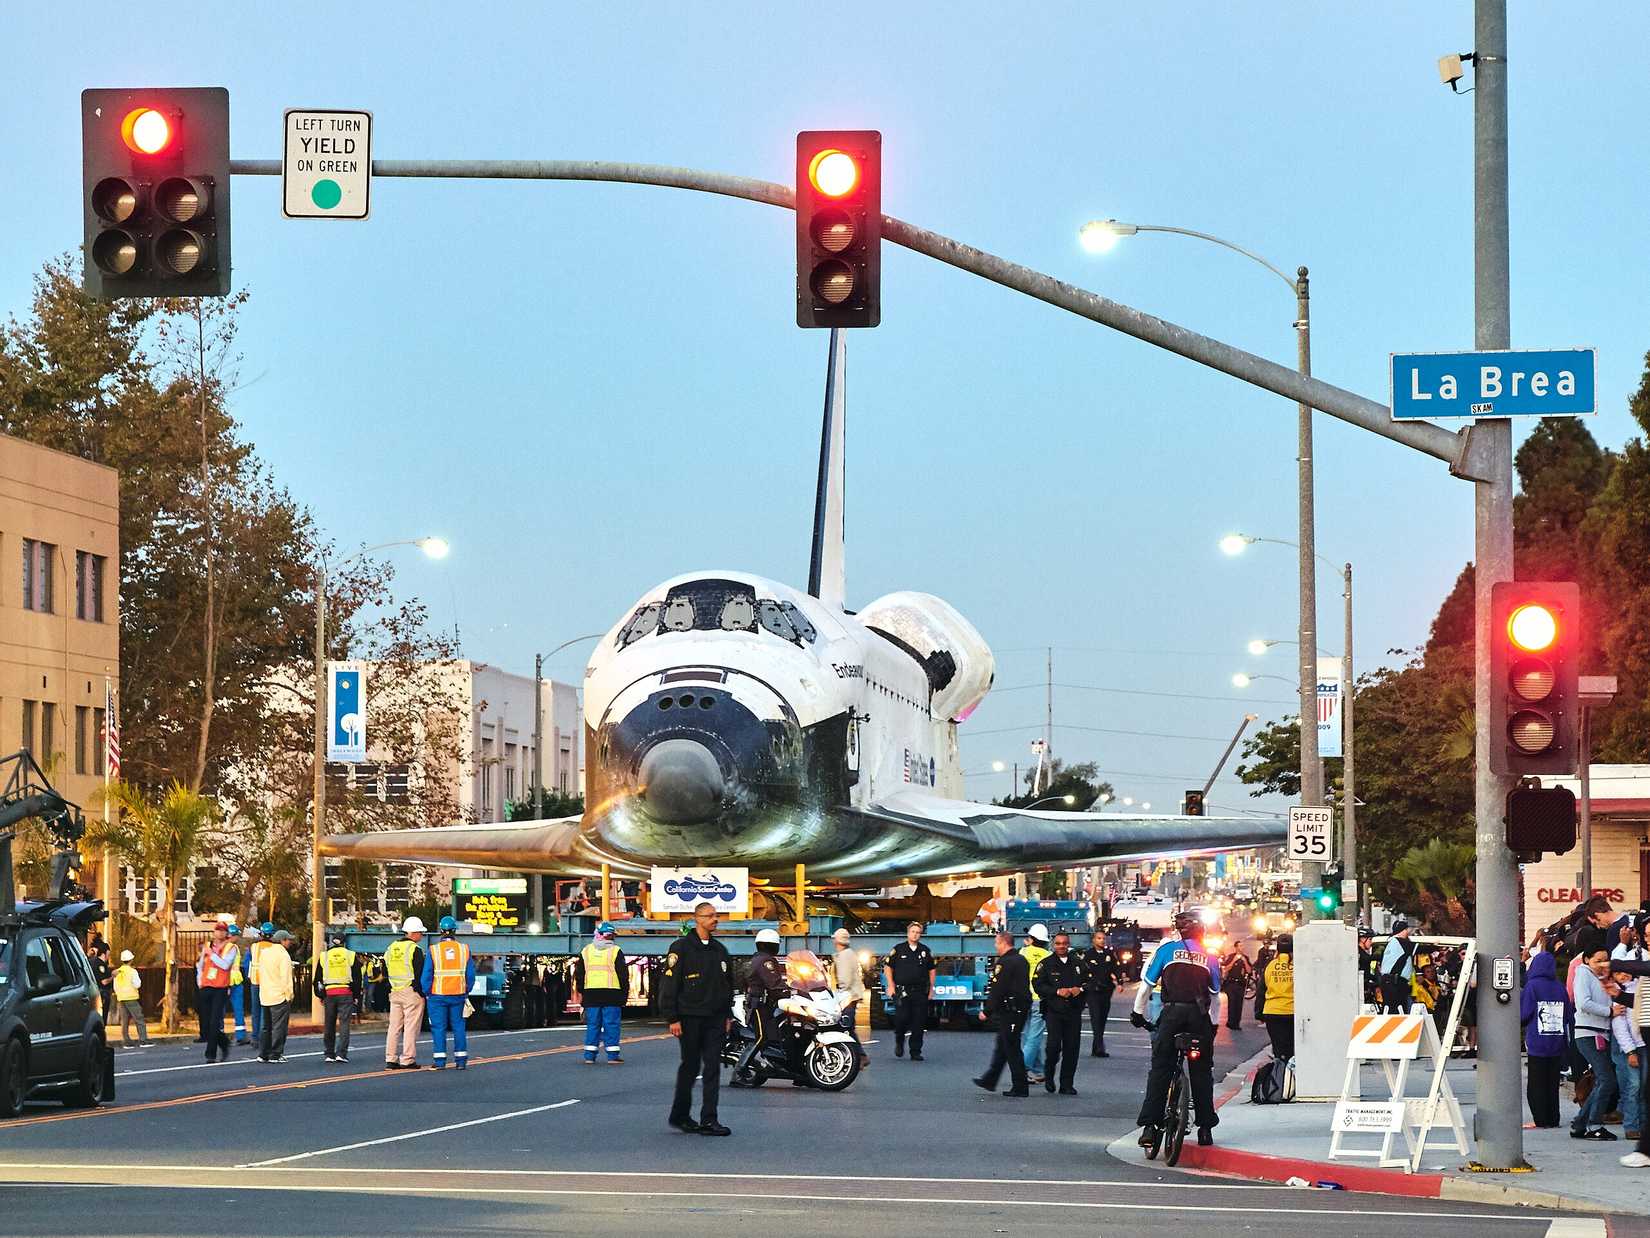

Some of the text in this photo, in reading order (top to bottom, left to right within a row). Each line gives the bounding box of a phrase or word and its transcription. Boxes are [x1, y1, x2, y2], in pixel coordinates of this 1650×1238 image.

[295, 118, 361, 132] LEFT TURN
[300, 137, 356, 154] YIELD
[297, 159, 358, 173] ON GREEN
[1411, 366, 1576, 400] La Brea
[1292, 812, 1329, 822] SPEED
[1296, 824, 1325, 833] LIMIT
[1293, 835, 1326, 854] 35
[1537, 888, 1625, 903] CLEAERS
[1173, 951, 1207, 963] SECURITY
[1275, 962, 1294, 971] CSC
